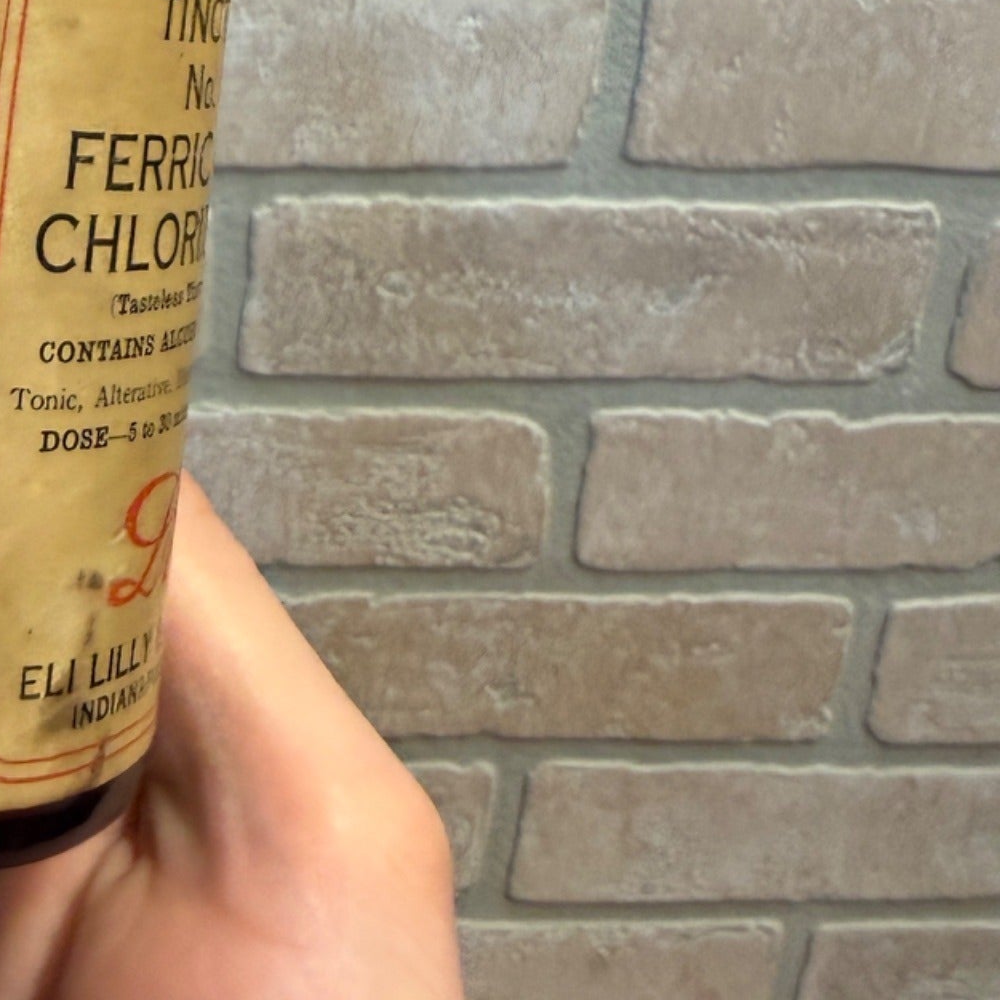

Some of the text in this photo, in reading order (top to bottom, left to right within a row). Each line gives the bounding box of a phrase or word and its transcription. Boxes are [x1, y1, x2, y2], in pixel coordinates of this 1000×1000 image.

[64, 131, 214, 192] FERRIC
[39, 334, 155, 363] CONTAINS
[10, 386, 84, 413] Tonic,
[19, 659, 76, 700] ELI
